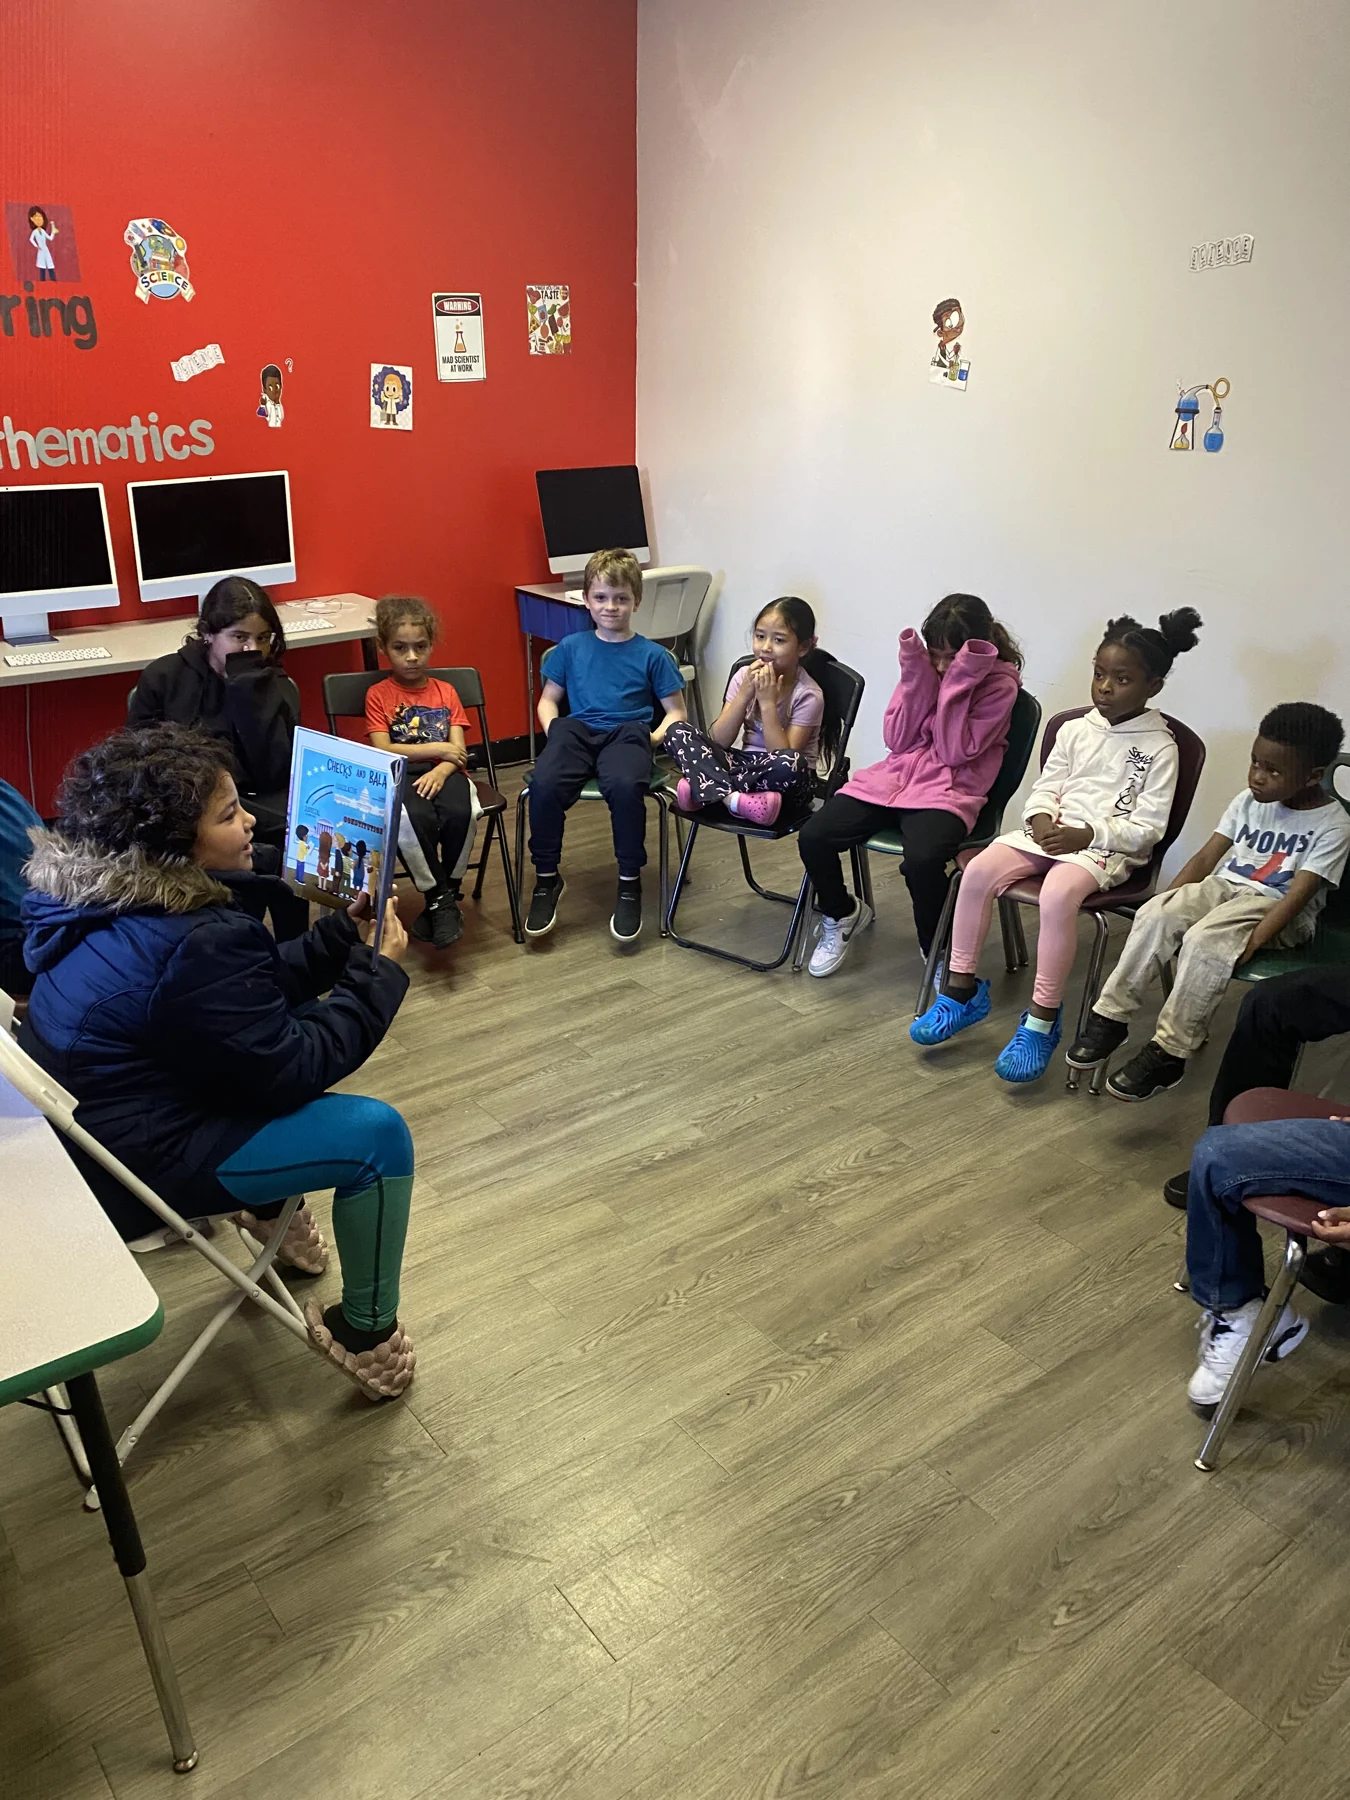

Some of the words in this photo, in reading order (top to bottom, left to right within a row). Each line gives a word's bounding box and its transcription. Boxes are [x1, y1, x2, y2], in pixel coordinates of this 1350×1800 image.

[141, 271, 189, 291] SCIENCE
[540, 290, 560, 300] TASTE
[443, 301, 472, 311] WARNING
[0, 280, 98, 350] ring
[442, 355, 454, 364] MAD
[454, 355, 480, 364] SCIENTIST
[450, 364, 457, 372] AT
[457, 364, 473, 372] WORK
[326, 758, 353, 779] CHECKS
[355, 768, 367, 779] AND
